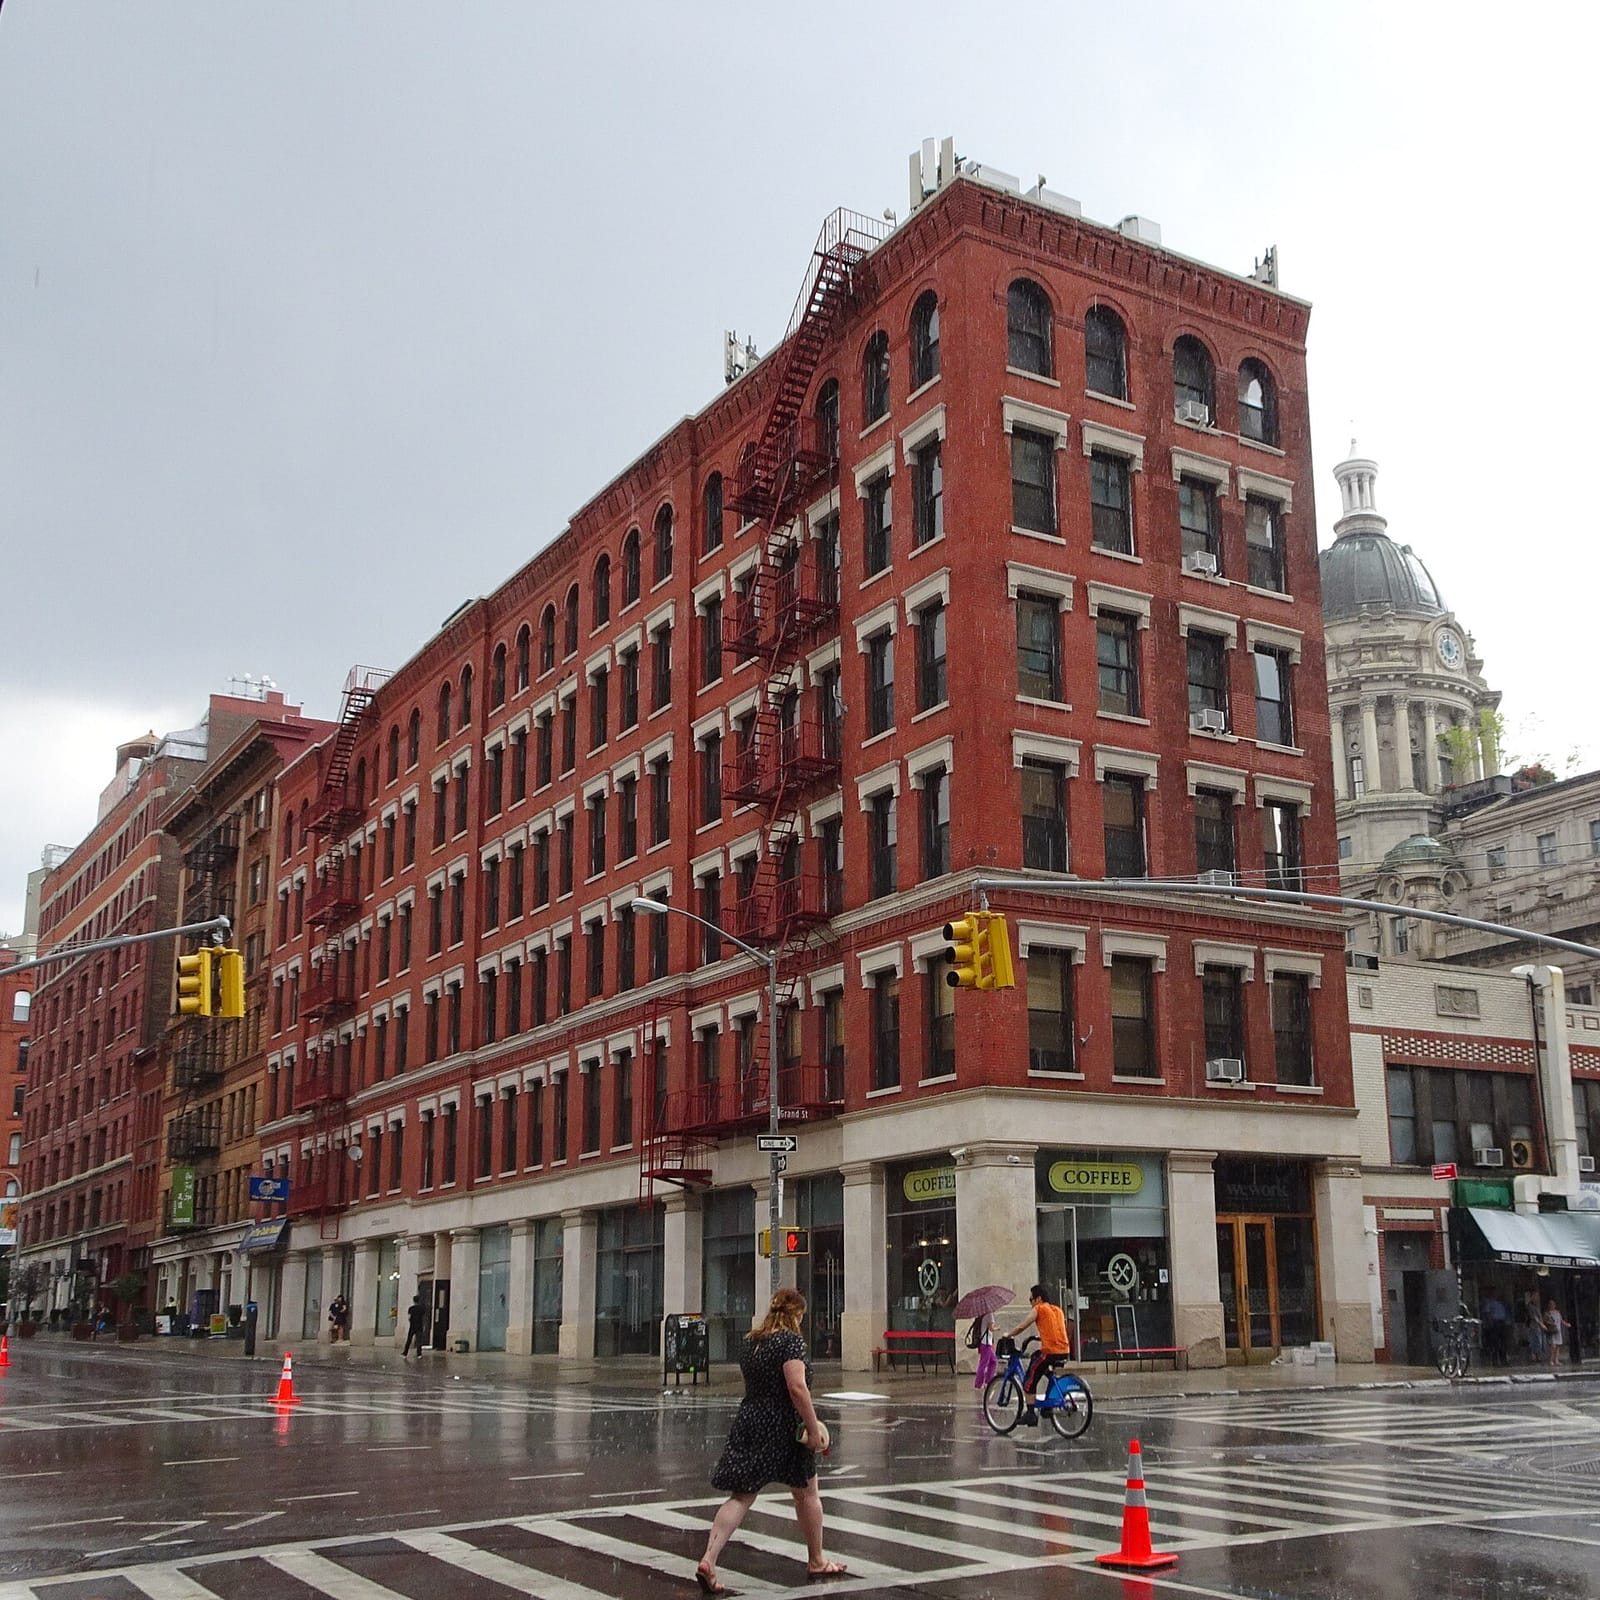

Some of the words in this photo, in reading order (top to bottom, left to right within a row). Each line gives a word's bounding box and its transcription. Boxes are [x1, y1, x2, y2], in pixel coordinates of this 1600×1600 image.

[781, 1110, 800, 1118] Grand
[801, 1110, 808, 1118] St
[913, 1175, 956, 1192] COFFE
[1064, 1170, 1131, 1185] COFFEE
